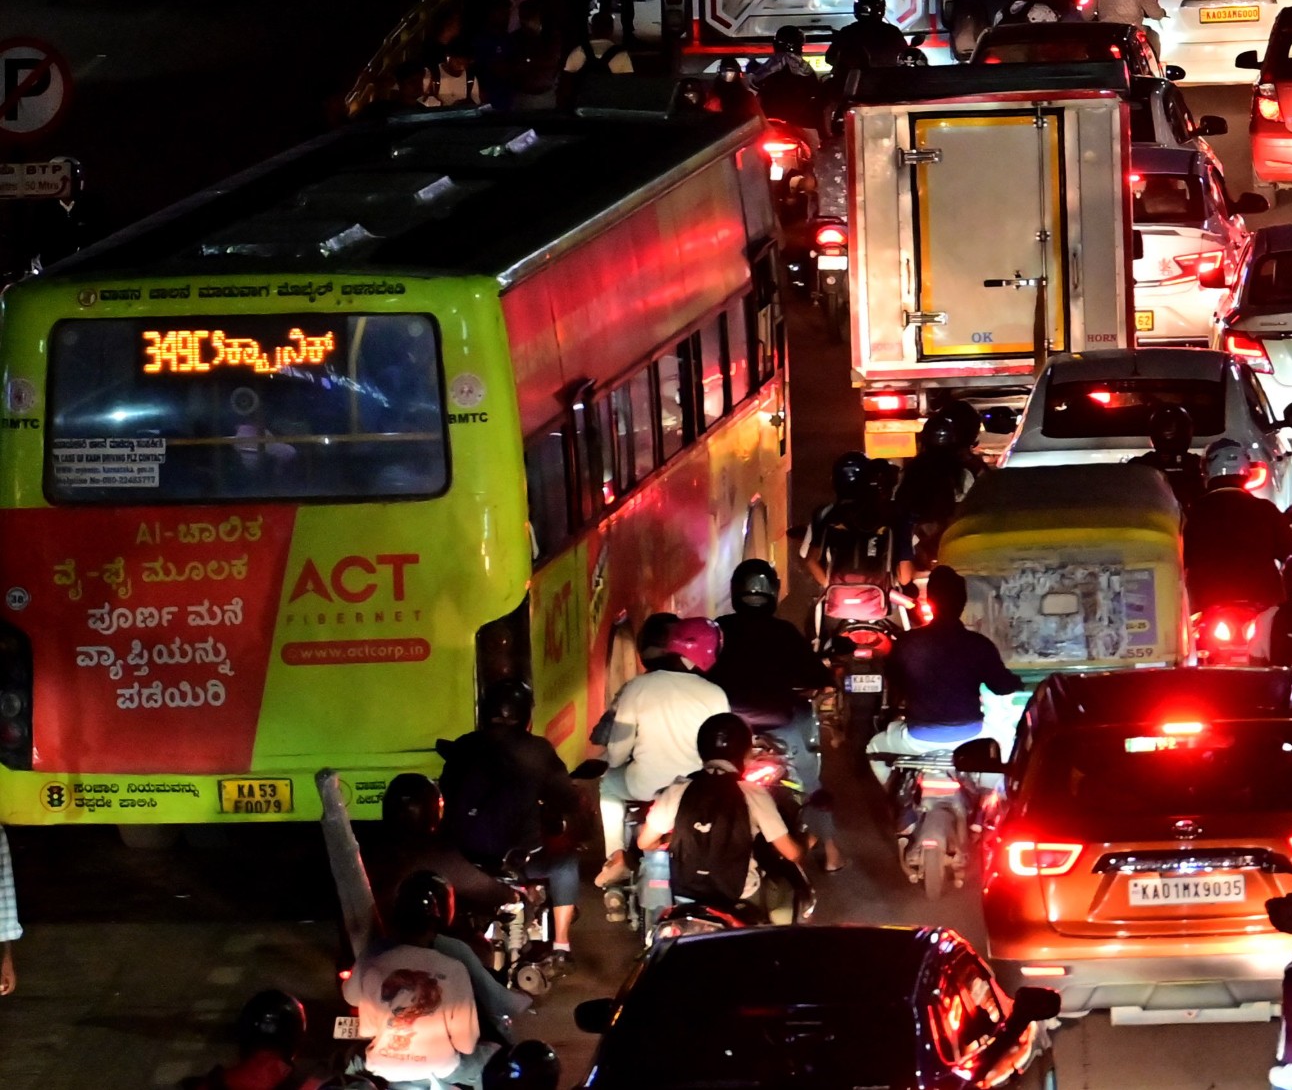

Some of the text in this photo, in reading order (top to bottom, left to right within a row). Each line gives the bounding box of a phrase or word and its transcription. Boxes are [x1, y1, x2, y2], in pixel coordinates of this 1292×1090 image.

[971, 332, 993, 344] OK
[1087, 334, 1117, 342] HORN
[143, 330, 209, 372] 349C
[448, 412, 488, 424] BMTC
[142, 554, 248, 583] ಮೂಲಕ
[289, 553, 420, 604] ACT
[88, 597, 243, 635] ಪೂರ್ಣ ಮನೆ
[286, 610, 422, 625] FIBERNET
[76, 637, 235, 680] ವ್ಯಾಪ್ತಿಯನ್ನು
[299, 644, 424, 661] www.actcorp.in
[117, 680, 226, 709] ಪಡೆಯಿರಿ
[237, 783, 277, 799] KA 53
[1141, 881, 1242, 898] KA01MX9035
